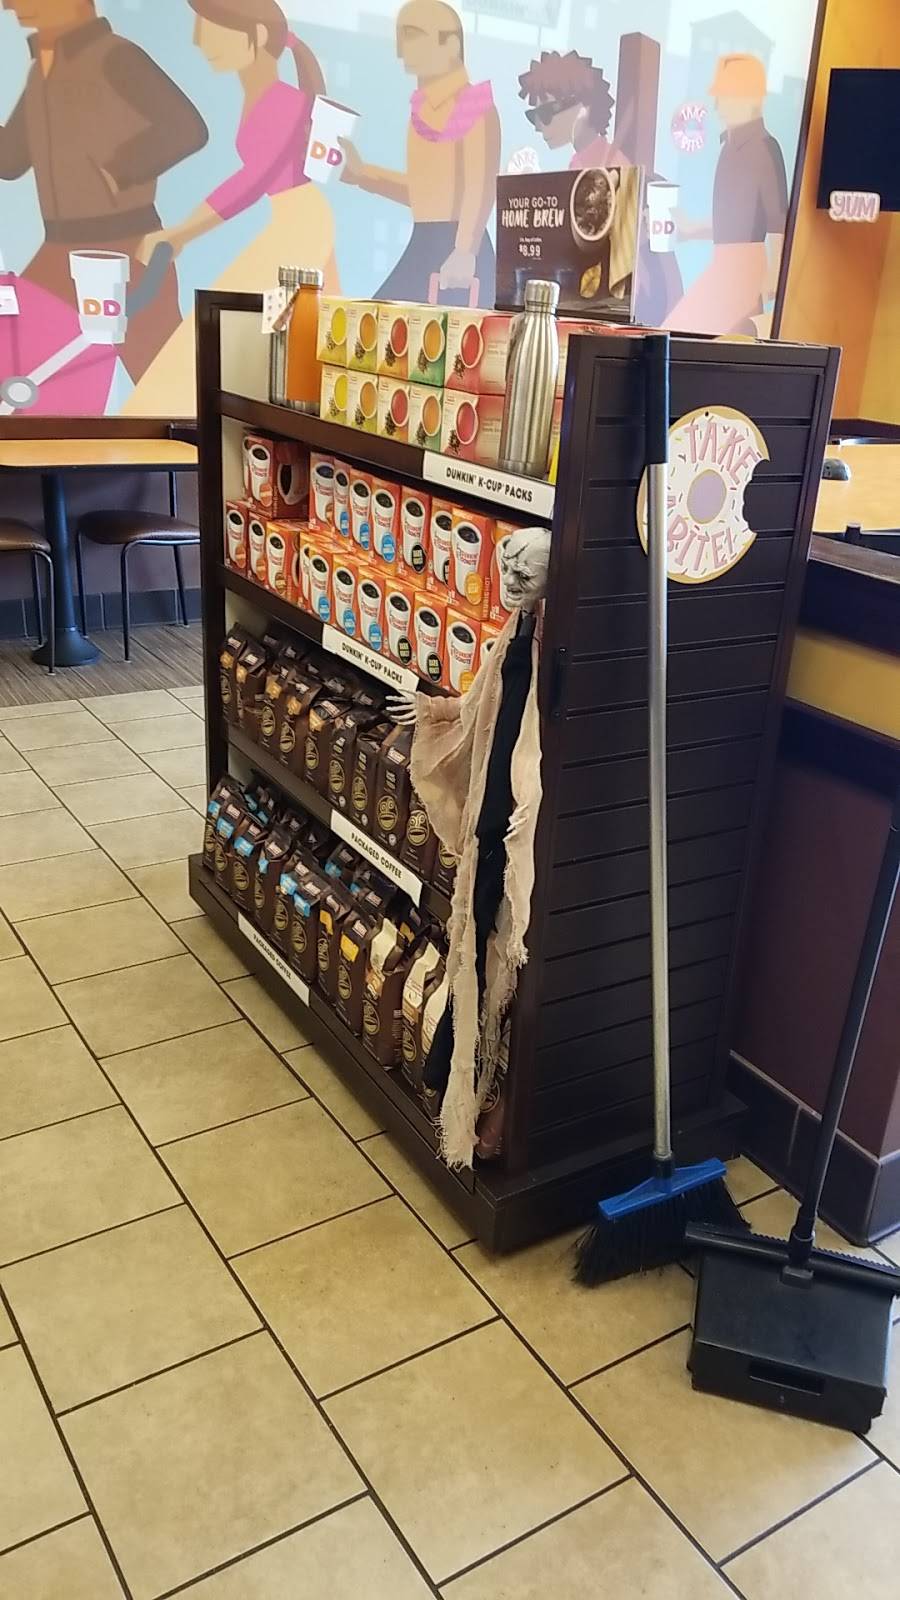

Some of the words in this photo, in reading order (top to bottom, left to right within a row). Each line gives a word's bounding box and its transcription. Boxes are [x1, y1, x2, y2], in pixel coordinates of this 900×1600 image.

[508, 197, 530, 209] YOUR
[531, 196, 558, 208] GO-TO
[501, 208, 529, 228] HOME
[533, 208, 565, 228] BREW
[518, 243, 541, 257] $8.99
[684, 421, 759, 486] TAKE
[446, 466, 477, 484] DUNKIN'
[504, 484, 533, 503] PACKS
[383, 666, 403, 685] PACKS
[351, 832, 380, 861] PACKAGED
[380, 856, 402, 879] COFFEE
